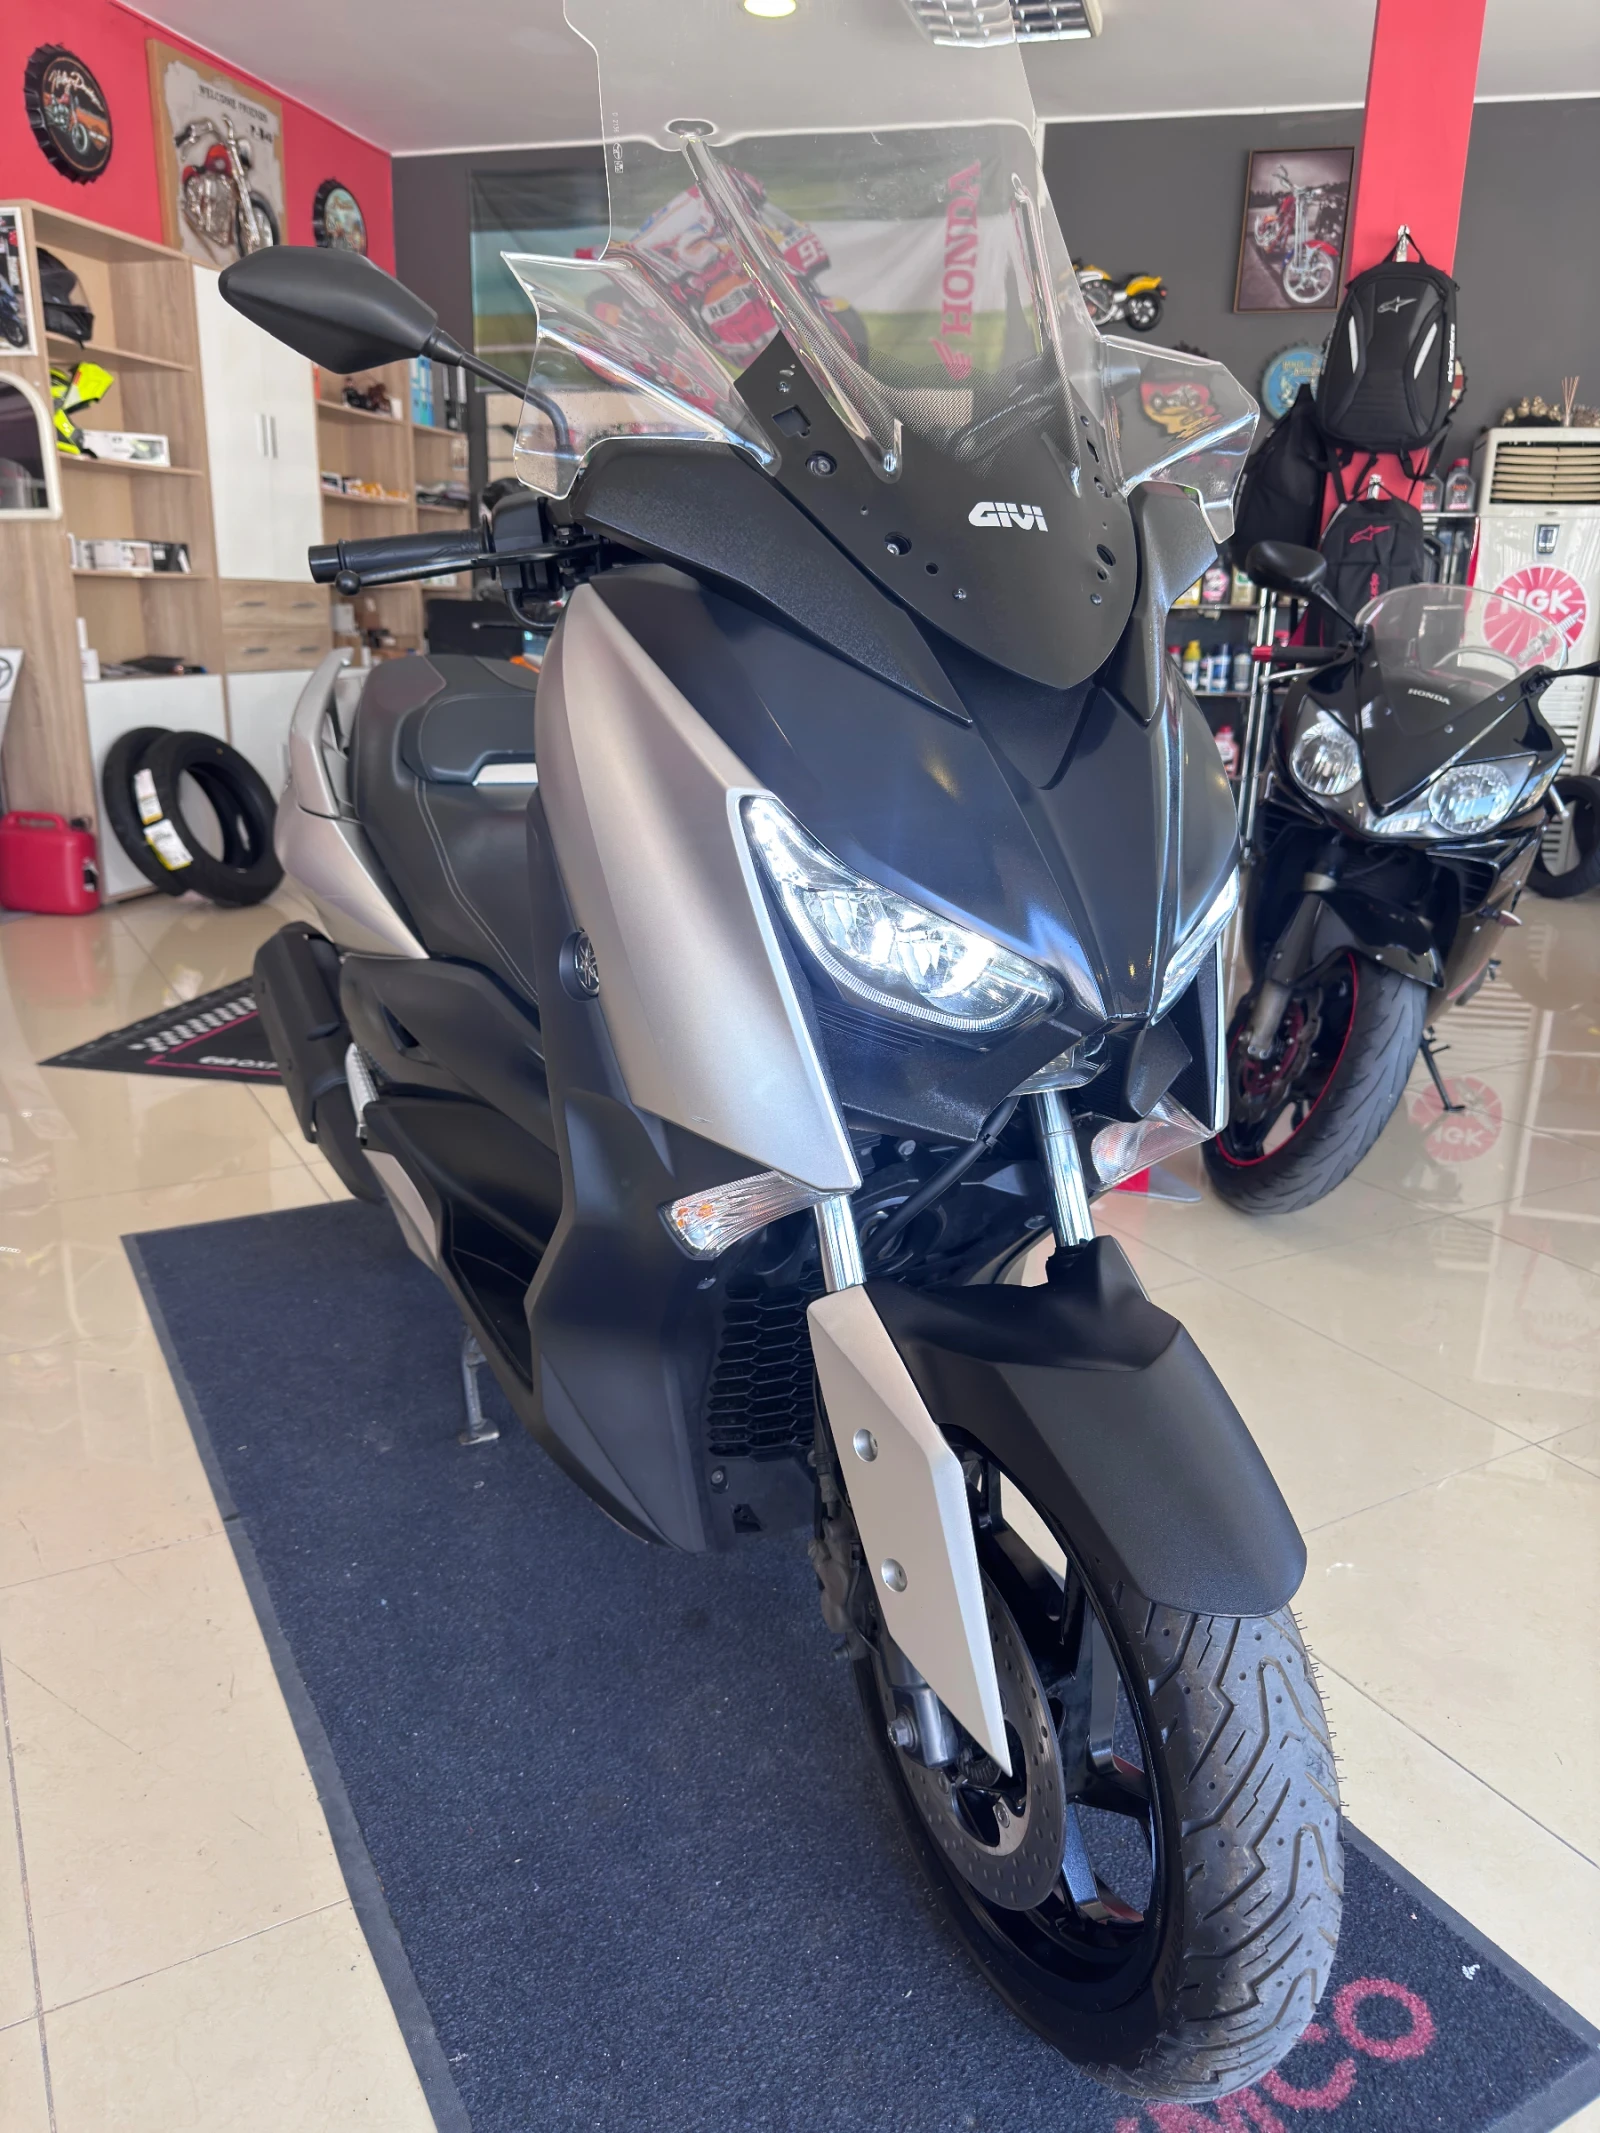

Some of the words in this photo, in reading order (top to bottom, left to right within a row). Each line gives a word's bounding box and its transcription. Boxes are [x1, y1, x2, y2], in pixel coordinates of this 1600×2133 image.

[941, 158, 982, 336] HONDA
[968, 501, 1049, 533] GIVI
[1500, 588, 1573, 615] NGK
[1407, 687, 1451, 706] HONDA
